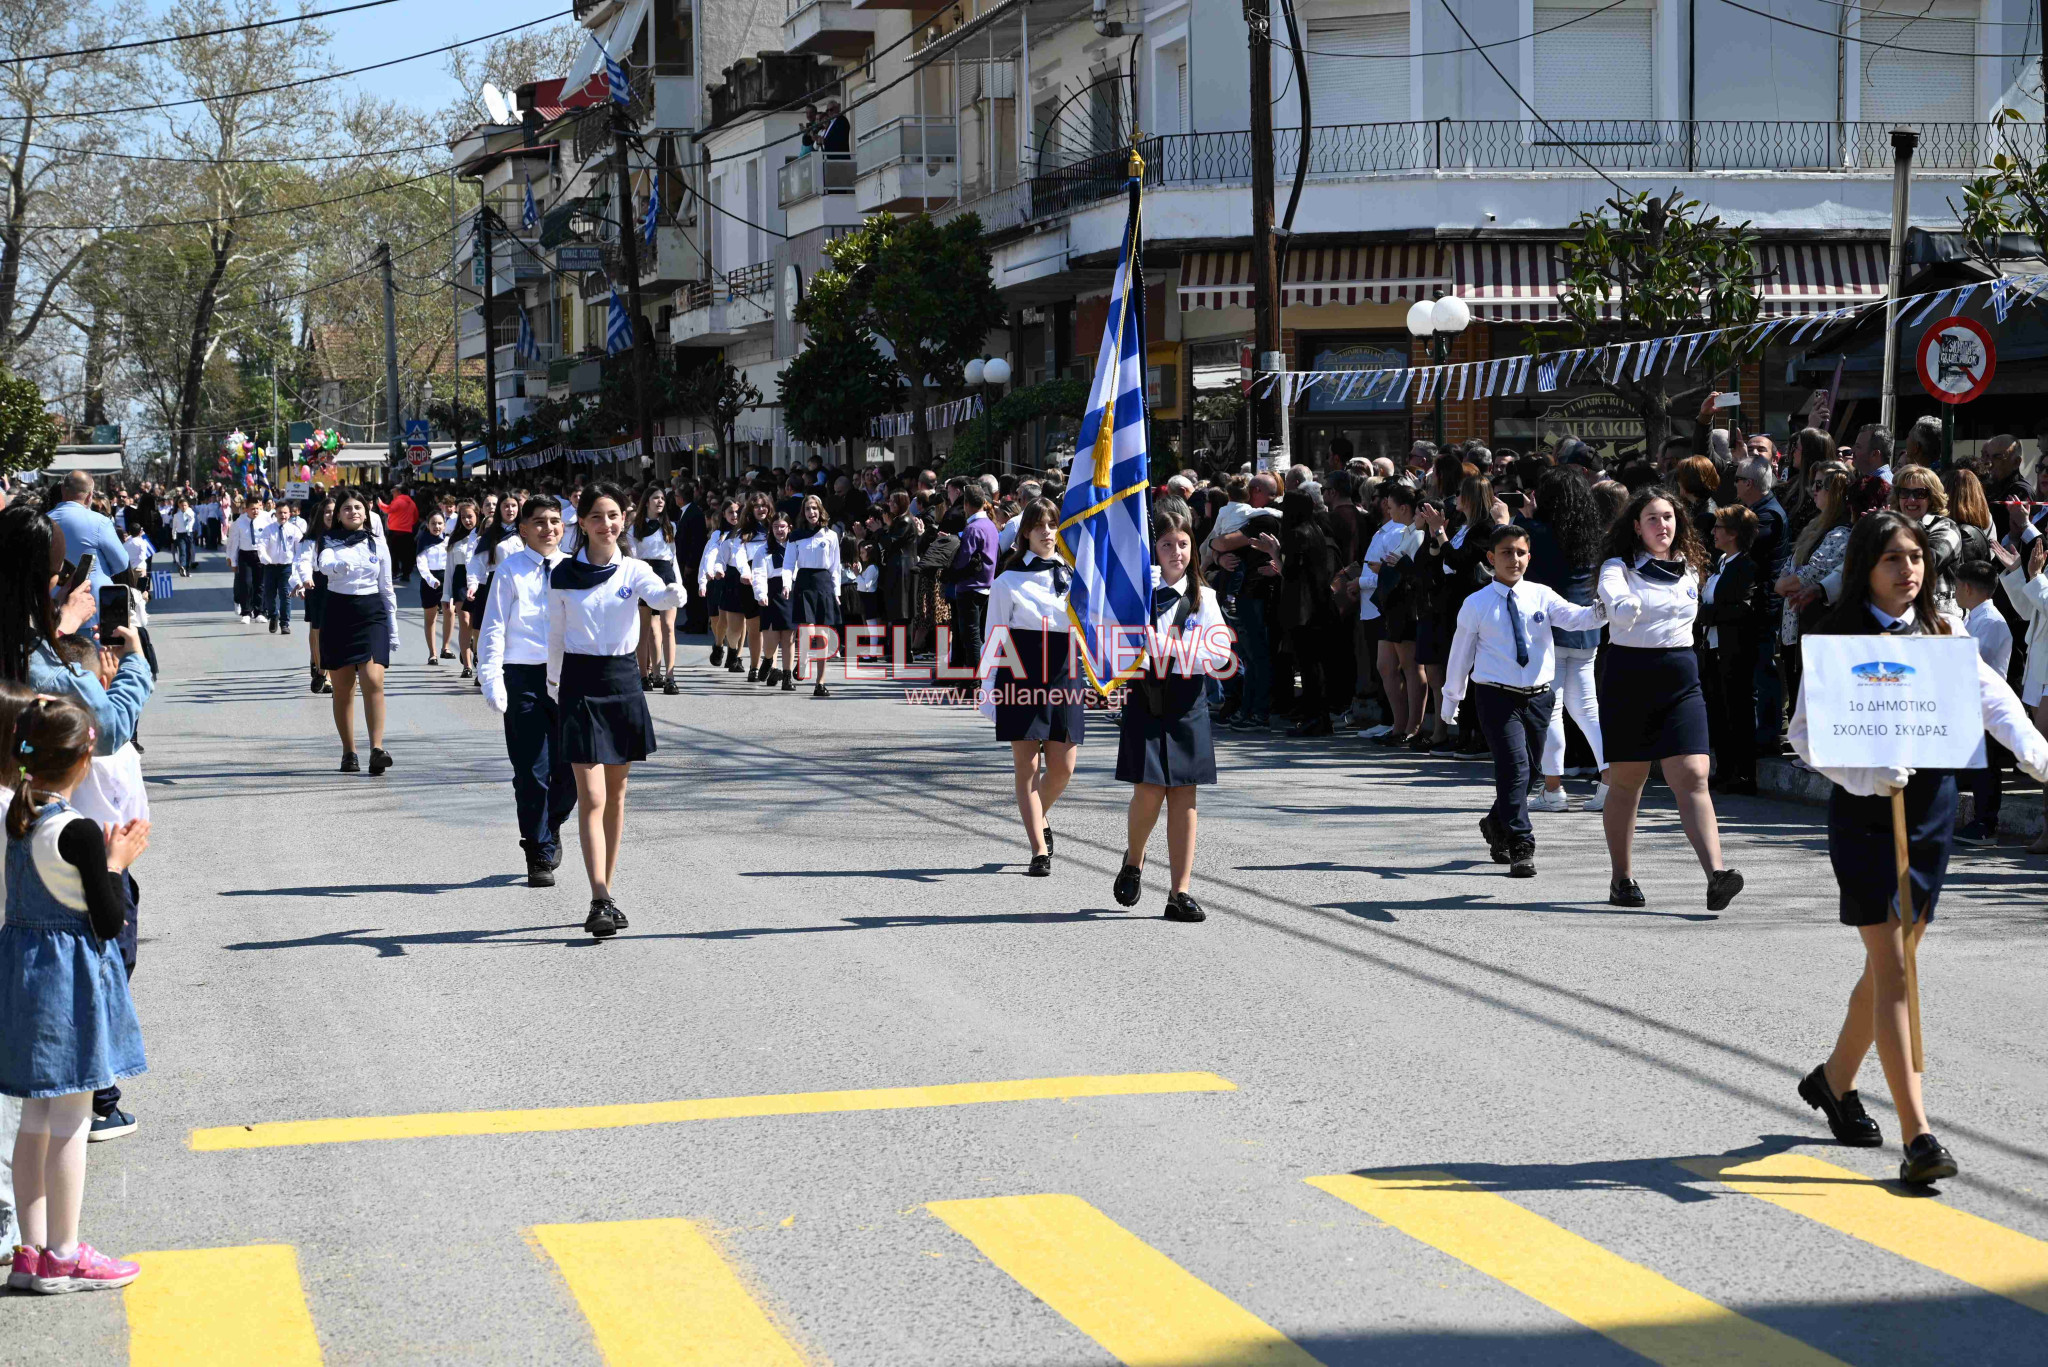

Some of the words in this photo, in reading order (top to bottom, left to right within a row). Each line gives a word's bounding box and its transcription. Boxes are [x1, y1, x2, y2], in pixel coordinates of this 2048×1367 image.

[408, 450, 427, 462] STOP
[1867, 700, 1937, 712] ΔΗΜΟΤΙΚΟ
[1833, 724, 1888, 736] ΣΧΟΛΕΙΟ
[1895, 724, 1949, 737] ΣΚΥΔΡΑΣ
